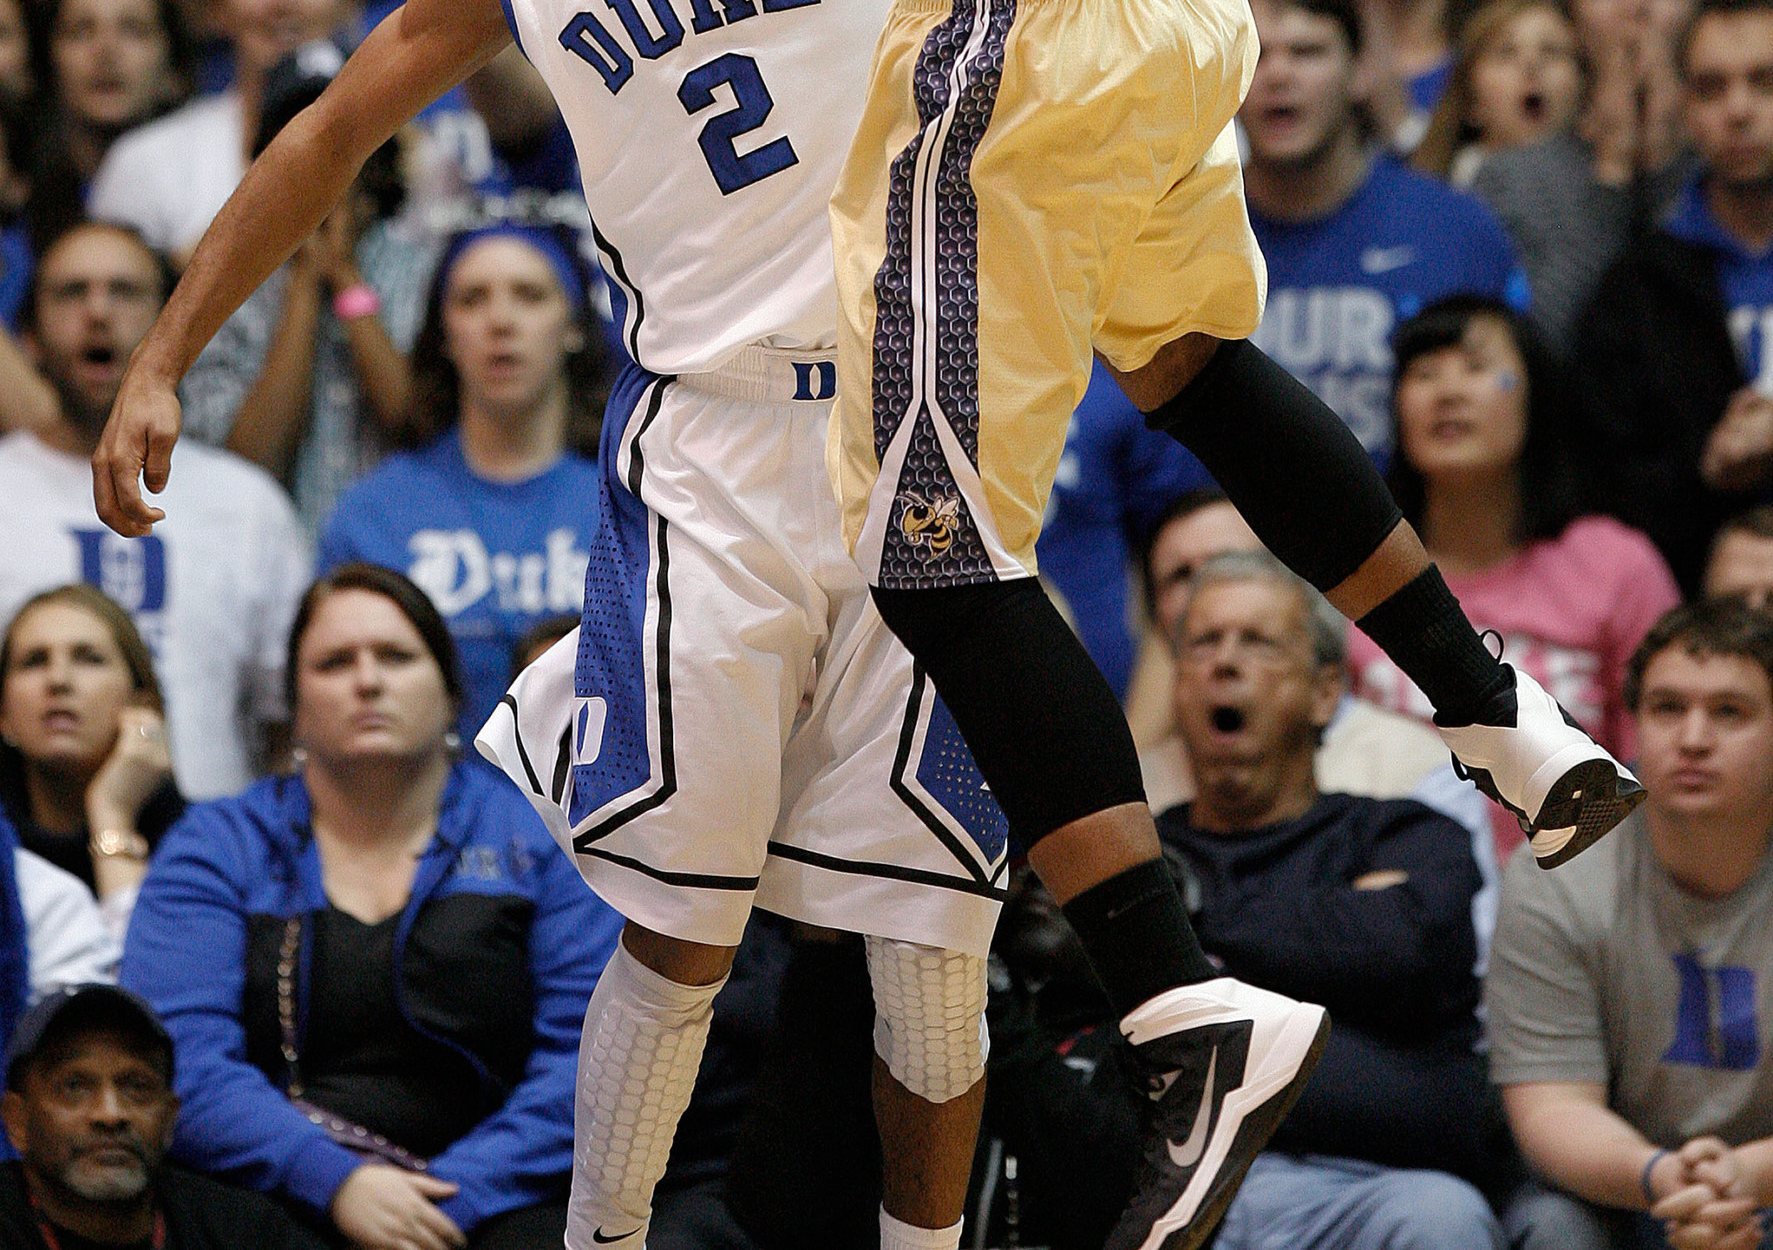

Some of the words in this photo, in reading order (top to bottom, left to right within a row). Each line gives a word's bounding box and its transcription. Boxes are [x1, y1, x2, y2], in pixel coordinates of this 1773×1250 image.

[676, 52, 799, 196] 2
[790, 360, 838, 401] D
[1661, 951, 1758, 1070] D
